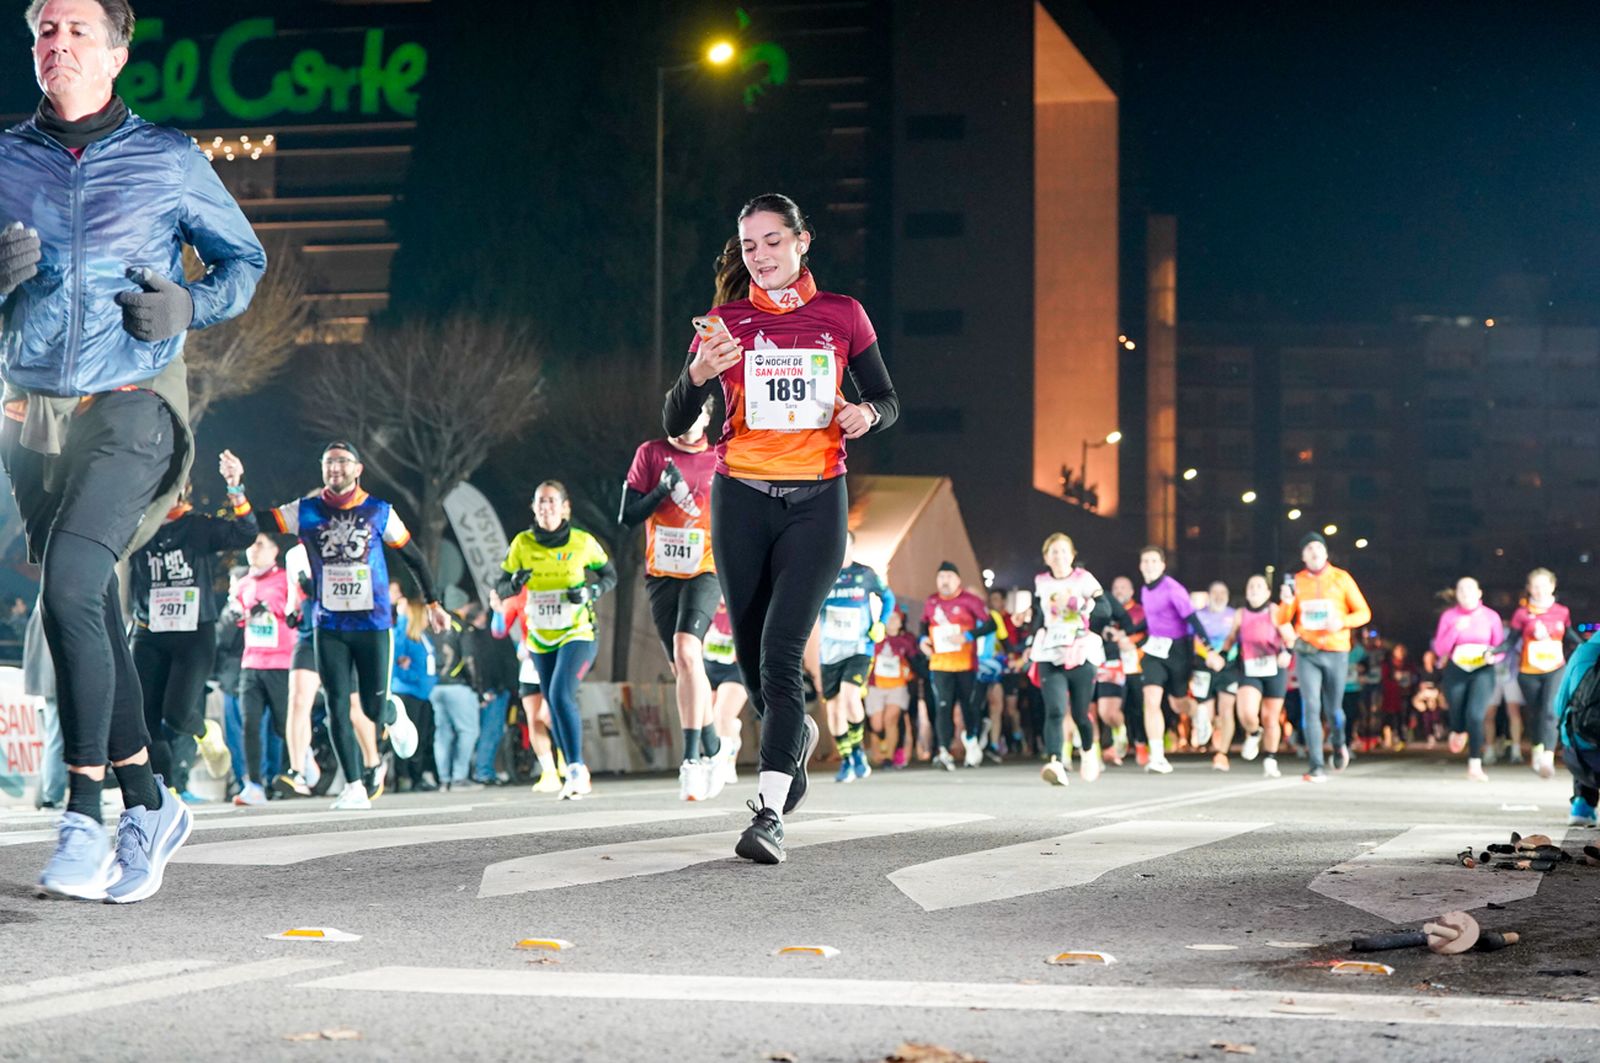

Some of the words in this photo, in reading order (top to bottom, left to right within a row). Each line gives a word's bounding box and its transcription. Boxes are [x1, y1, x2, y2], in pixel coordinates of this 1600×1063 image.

[210, 17, 428, 120] Corte
[765, 358, 791, 366] NOCHE
[793, 358, 803, 366] DE
[755, 368, 773, 376] SAN
[765, 378, 816, 401] 1891
[664, 544, 691, 558] 3741
[332, 583, 362, 595] 2972
[160, 604, 187, 616] 2971
[0, 704, 35, 735] SAN
